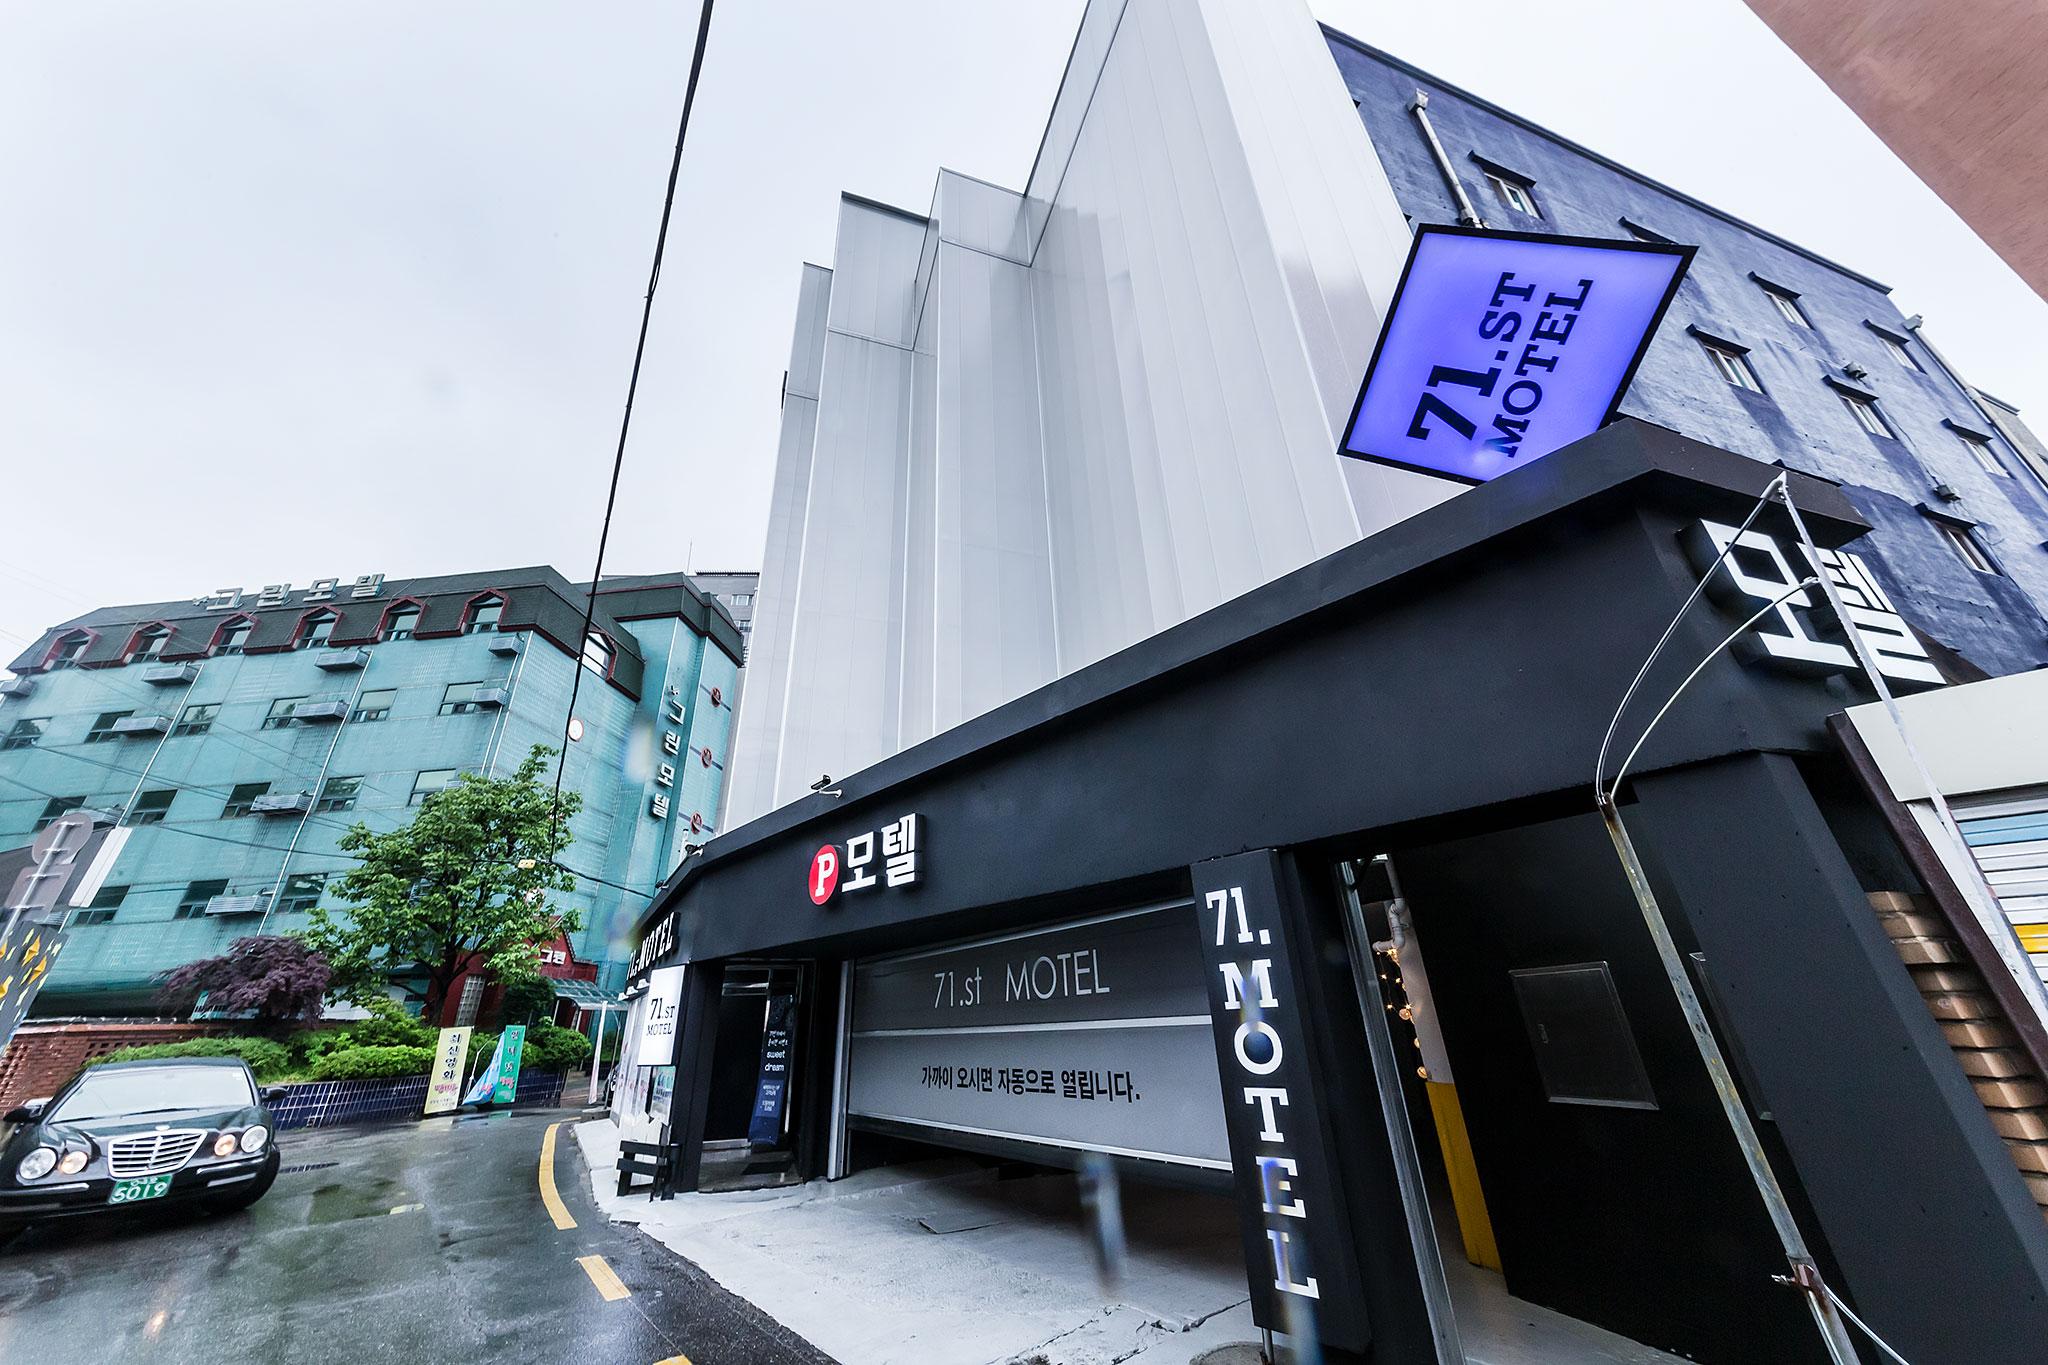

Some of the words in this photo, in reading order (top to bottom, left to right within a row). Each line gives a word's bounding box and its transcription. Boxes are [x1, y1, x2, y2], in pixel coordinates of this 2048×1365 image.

[1406, 272, 1537, 442] 71.ST
[1484, 278, 1595, 458] MOTEL
[1700, 518, 1947, 685] 모텔
[841, 812, 916, 892] 모텔
[637, 911, 675, 972] MOTEL
[1205, 886, 1272, 946] 71.
[649, 997, 676, 1020] 71.ST
[934, 966, 983, 1009] 71.st
[1005, 948, 1111, 1002] MOTEL
[646, 1022, 673, 1037] MOTEL
[766, 1050, 786, 1060] sweet
[764, 1062, 785, 1073] dream
[922, 1065, 953, 1090] 가까이
[956, 1066, 993, 1093] 오시면
[998, 1067, 1056, 1096] 자동으로
[1061, 1069, 1141, 1103] 열립니다.
[1218, 958, 1320, 1300] MOTEL
[112, 1181, 168, 1202] 5019
